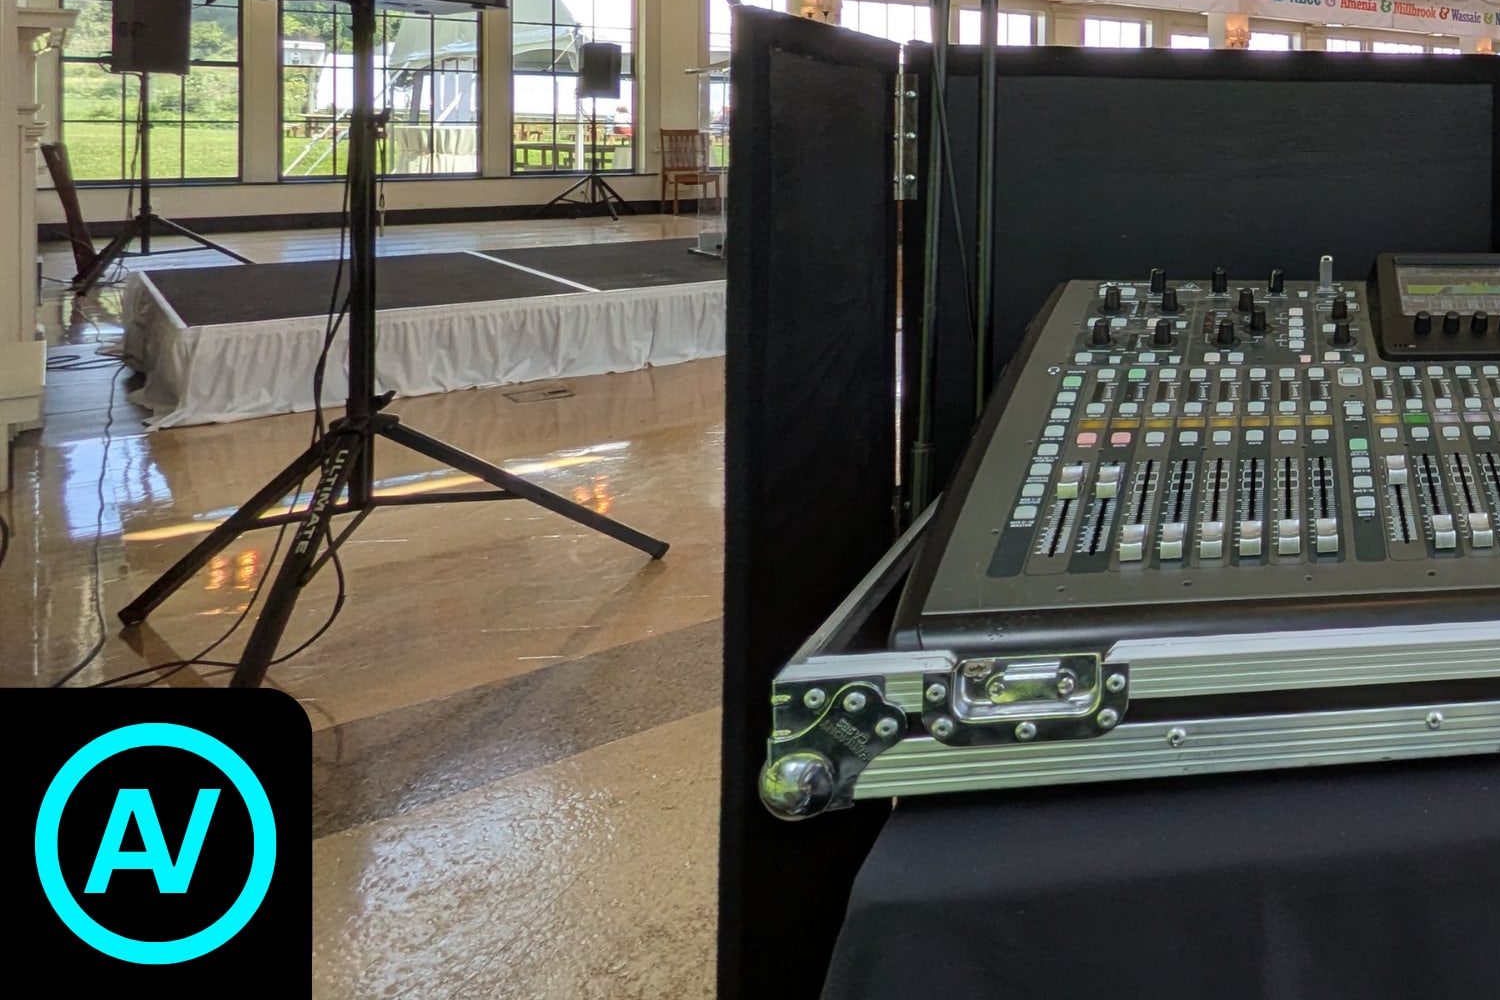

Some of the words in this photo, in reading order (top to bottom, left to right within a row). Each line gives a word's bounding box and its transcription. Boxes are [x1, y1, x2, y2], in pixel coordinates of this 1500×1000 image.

[1380, 0, 1393, 14] &
[1394, 1, 1437, 20] Millbrook
[1439, 7, 1449, 20] &
[1451, 8, 1482, 24] Wassaic
[1484, 12, 1494, 25] &
